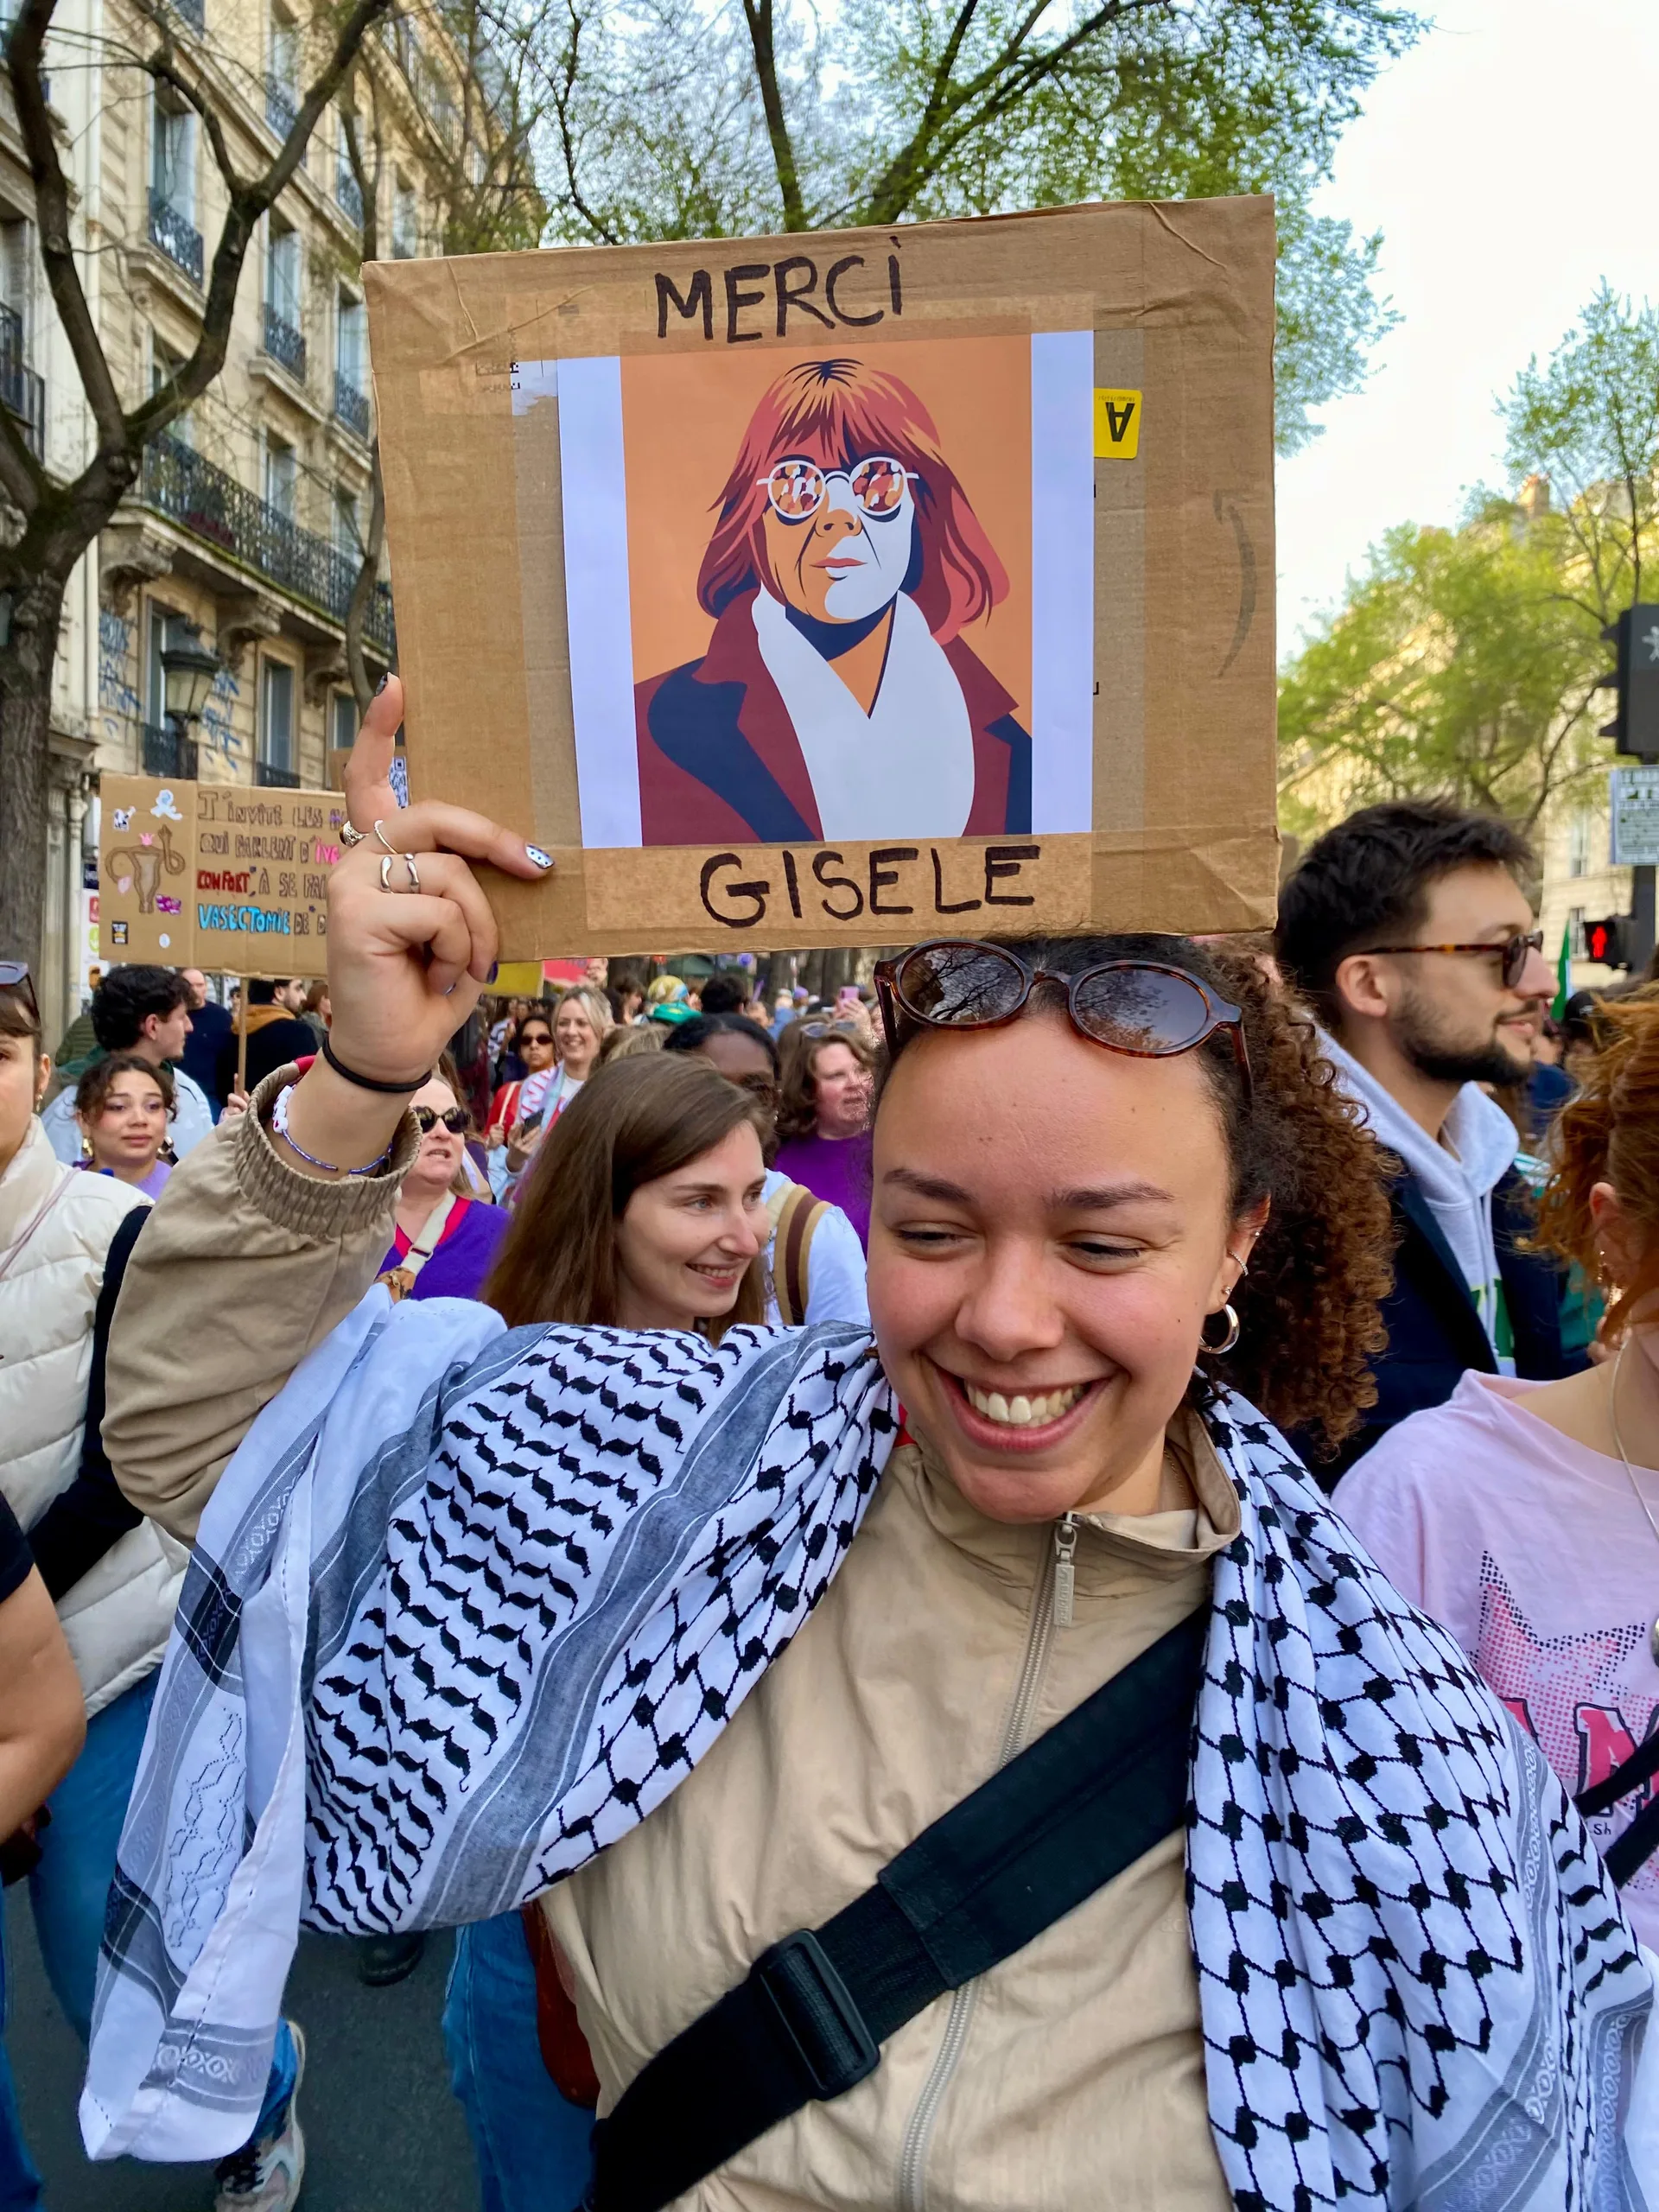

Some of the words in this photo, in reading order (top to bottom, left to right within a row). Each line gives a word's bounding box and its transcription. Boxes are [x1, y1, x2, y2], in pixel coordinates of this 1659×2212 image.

[293, 806, 322, 828] LES
[235, 834, 296, 861] PARLENT
[259, 868, 270, 894] À
[279, 873, 297, 897] SE
[304, 874, 327, 899] FAI
[700, 845, 1041, 928] GISELE
[294, 912, 308, 935] DE
